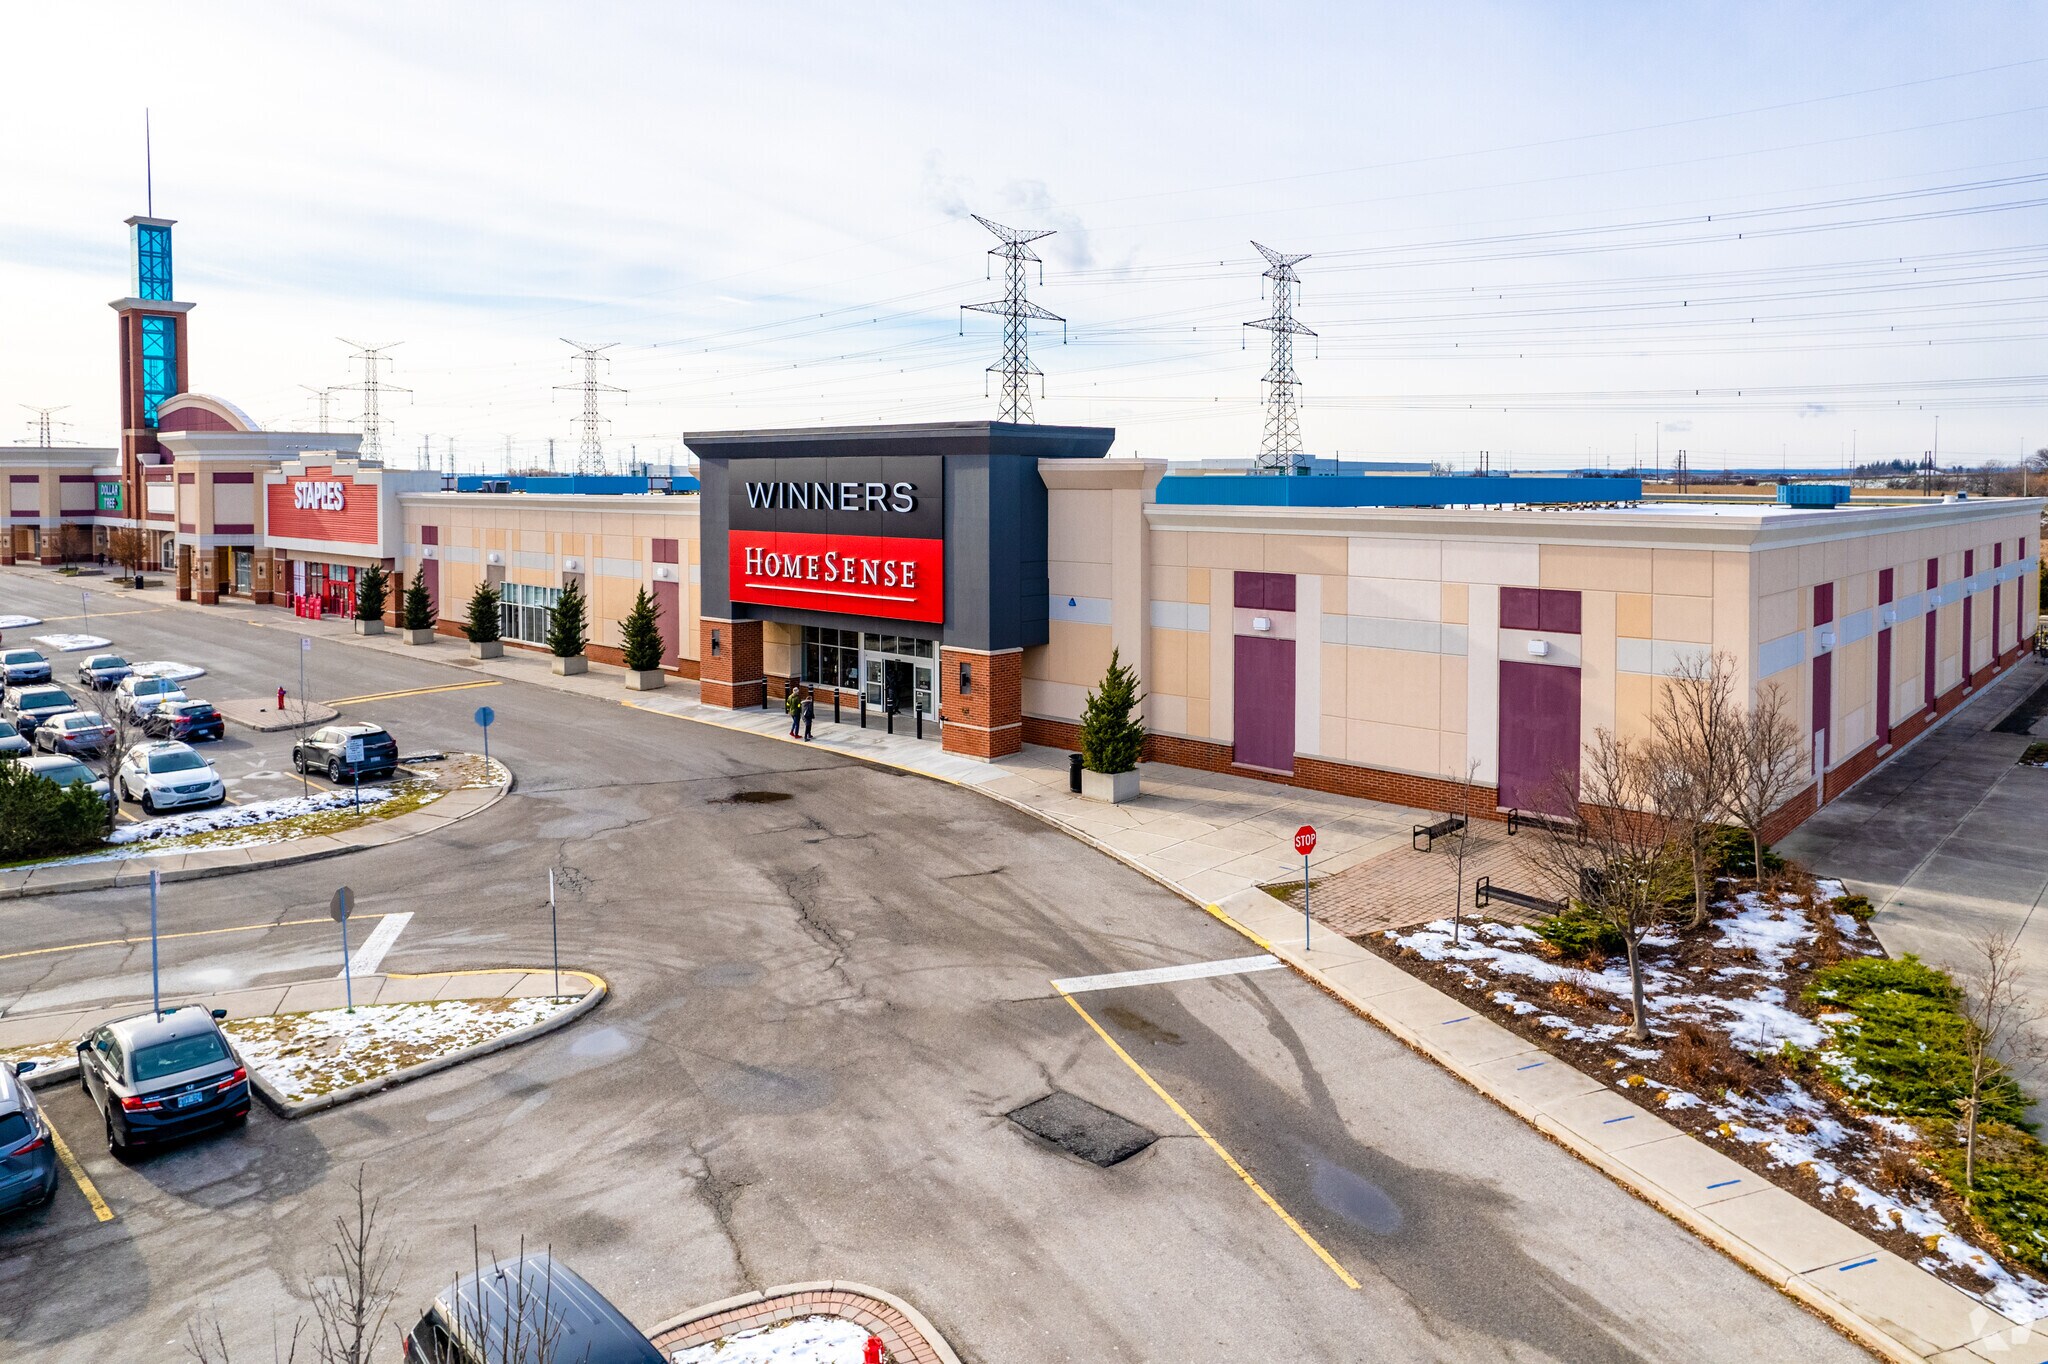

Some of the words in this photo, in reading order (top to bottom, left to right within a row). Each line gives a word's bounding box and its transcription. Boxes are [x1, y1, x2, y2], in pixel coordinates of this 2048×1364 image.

[294, 481, 345, 511] STAPLES
[745, 482, 915, 513] WINNERS
[1295, 833, 1316, 848] STOP
